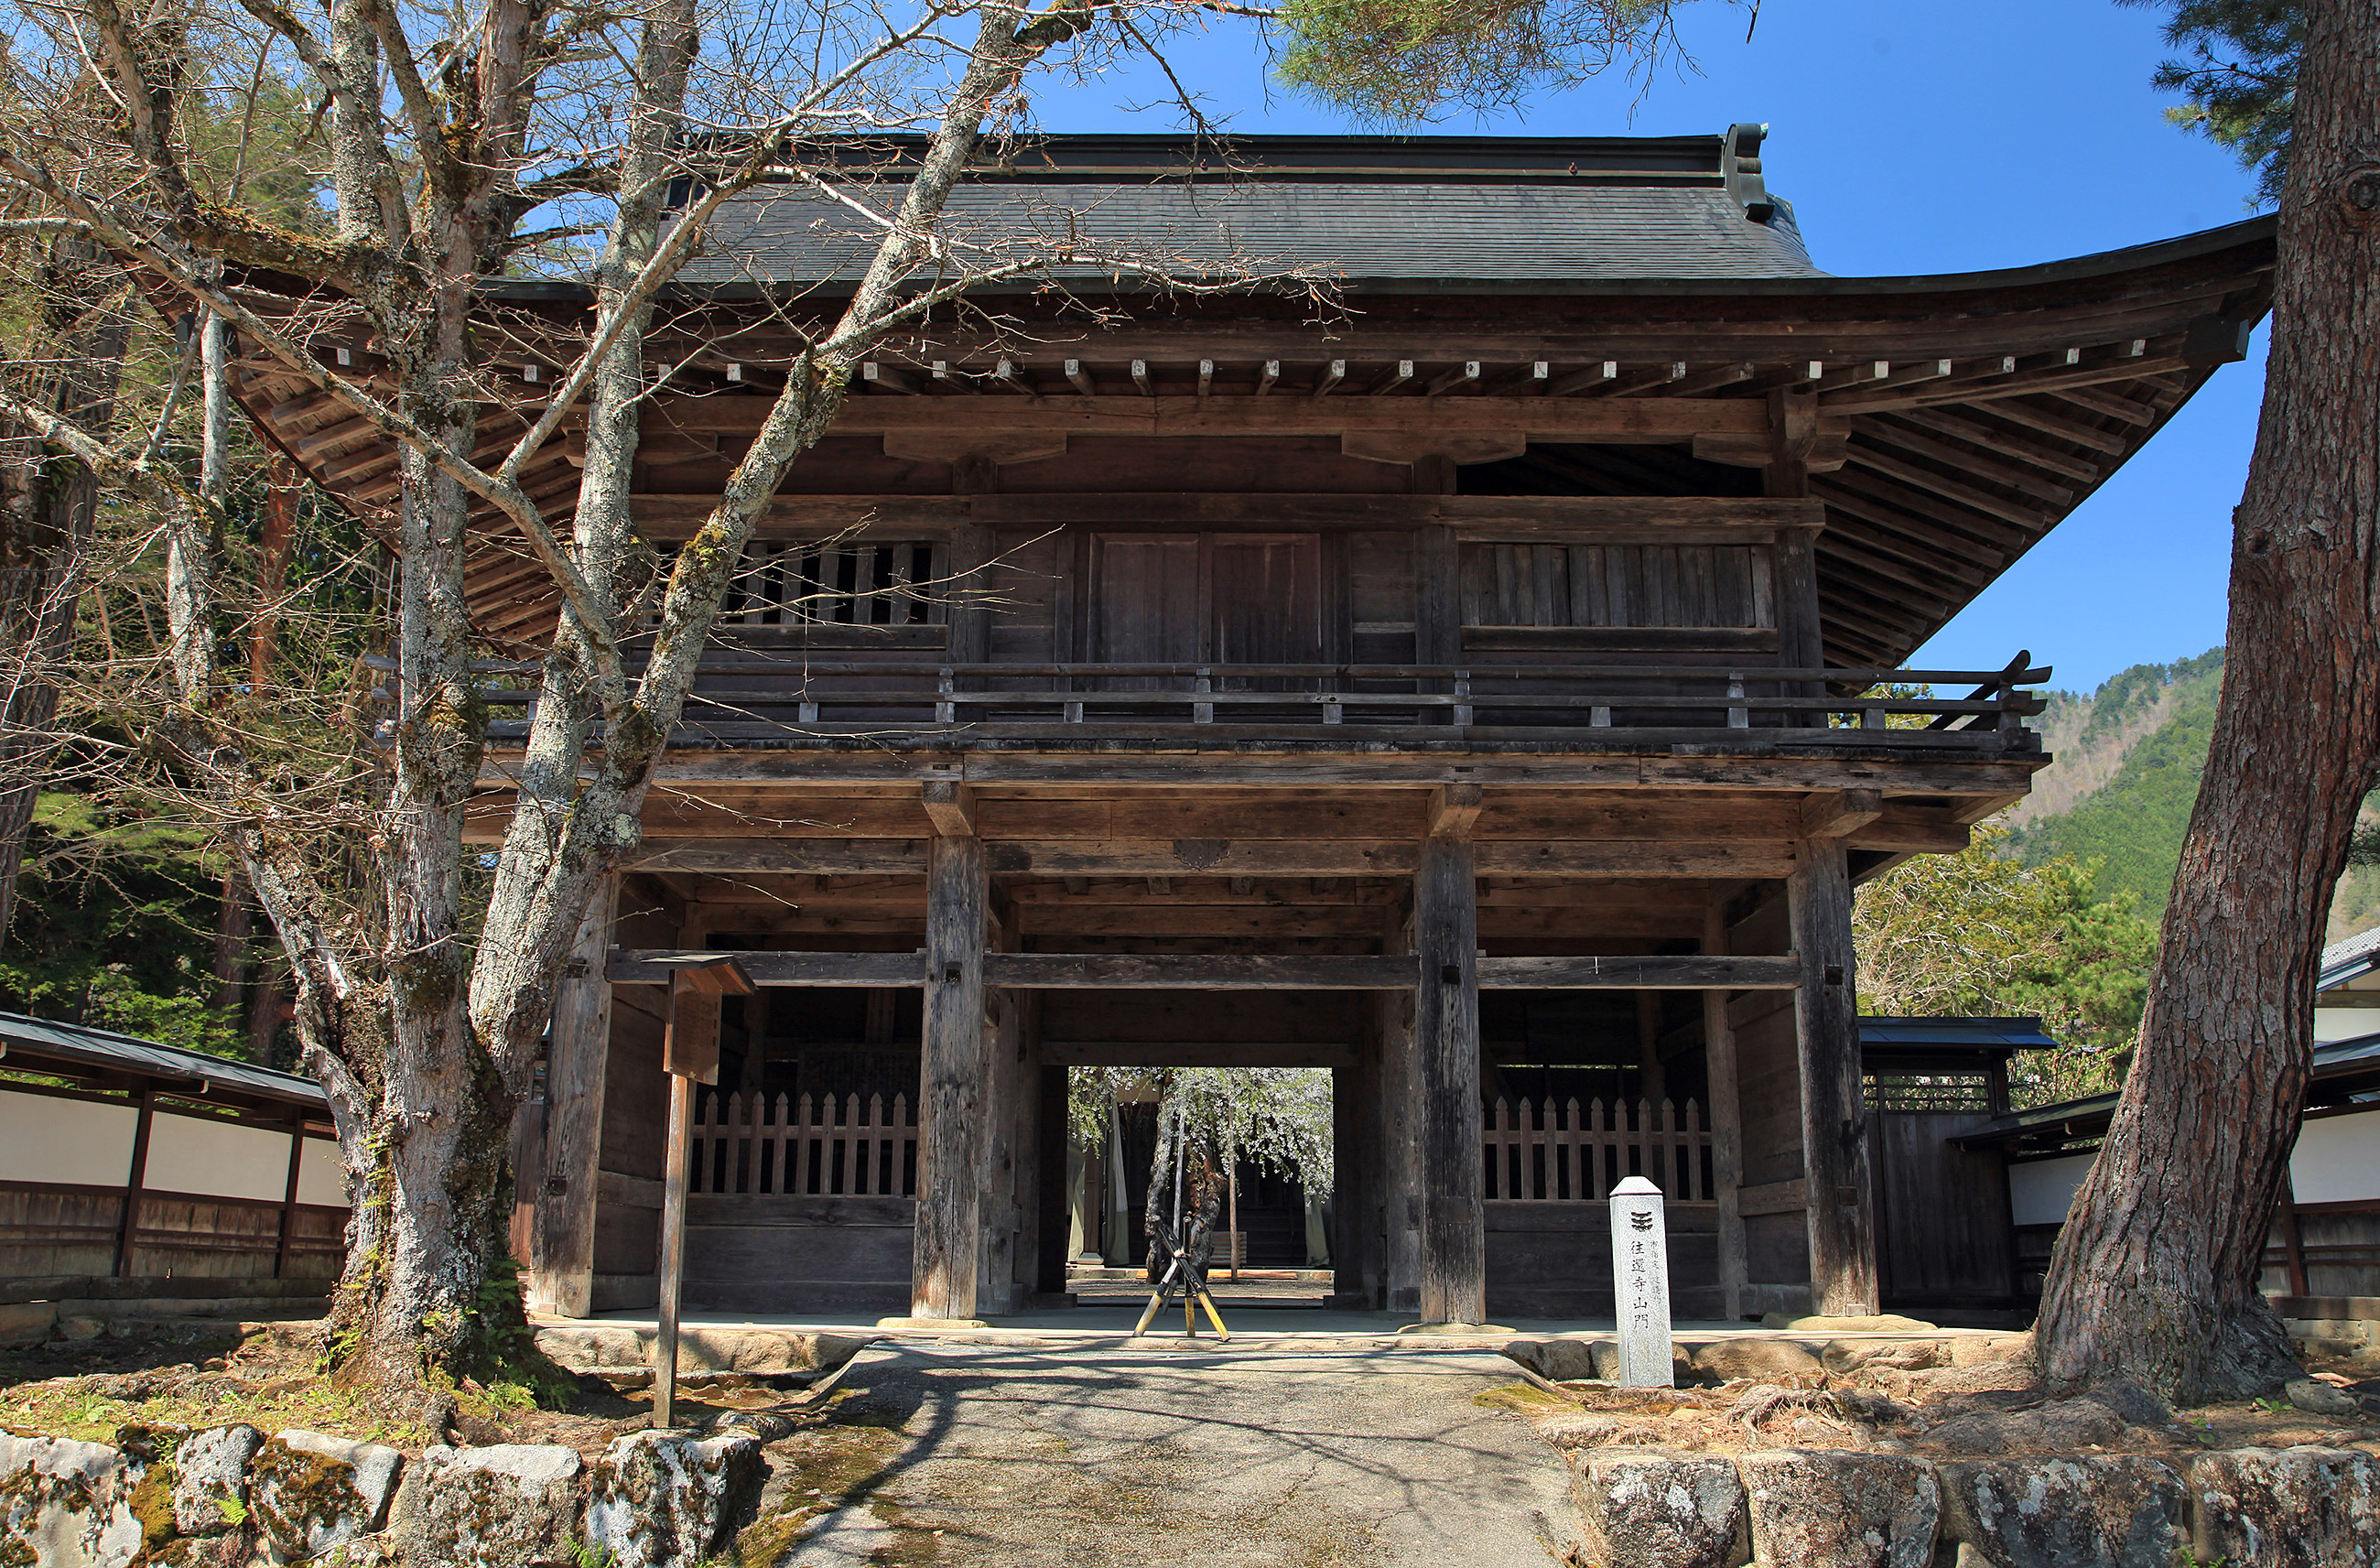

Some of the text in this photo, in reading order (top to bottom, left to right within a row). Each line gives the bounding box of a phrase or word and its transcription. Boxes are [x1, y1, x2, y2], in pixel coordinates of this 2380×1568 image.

[1630, 1240, 1649, 1329] 往還寺山門
